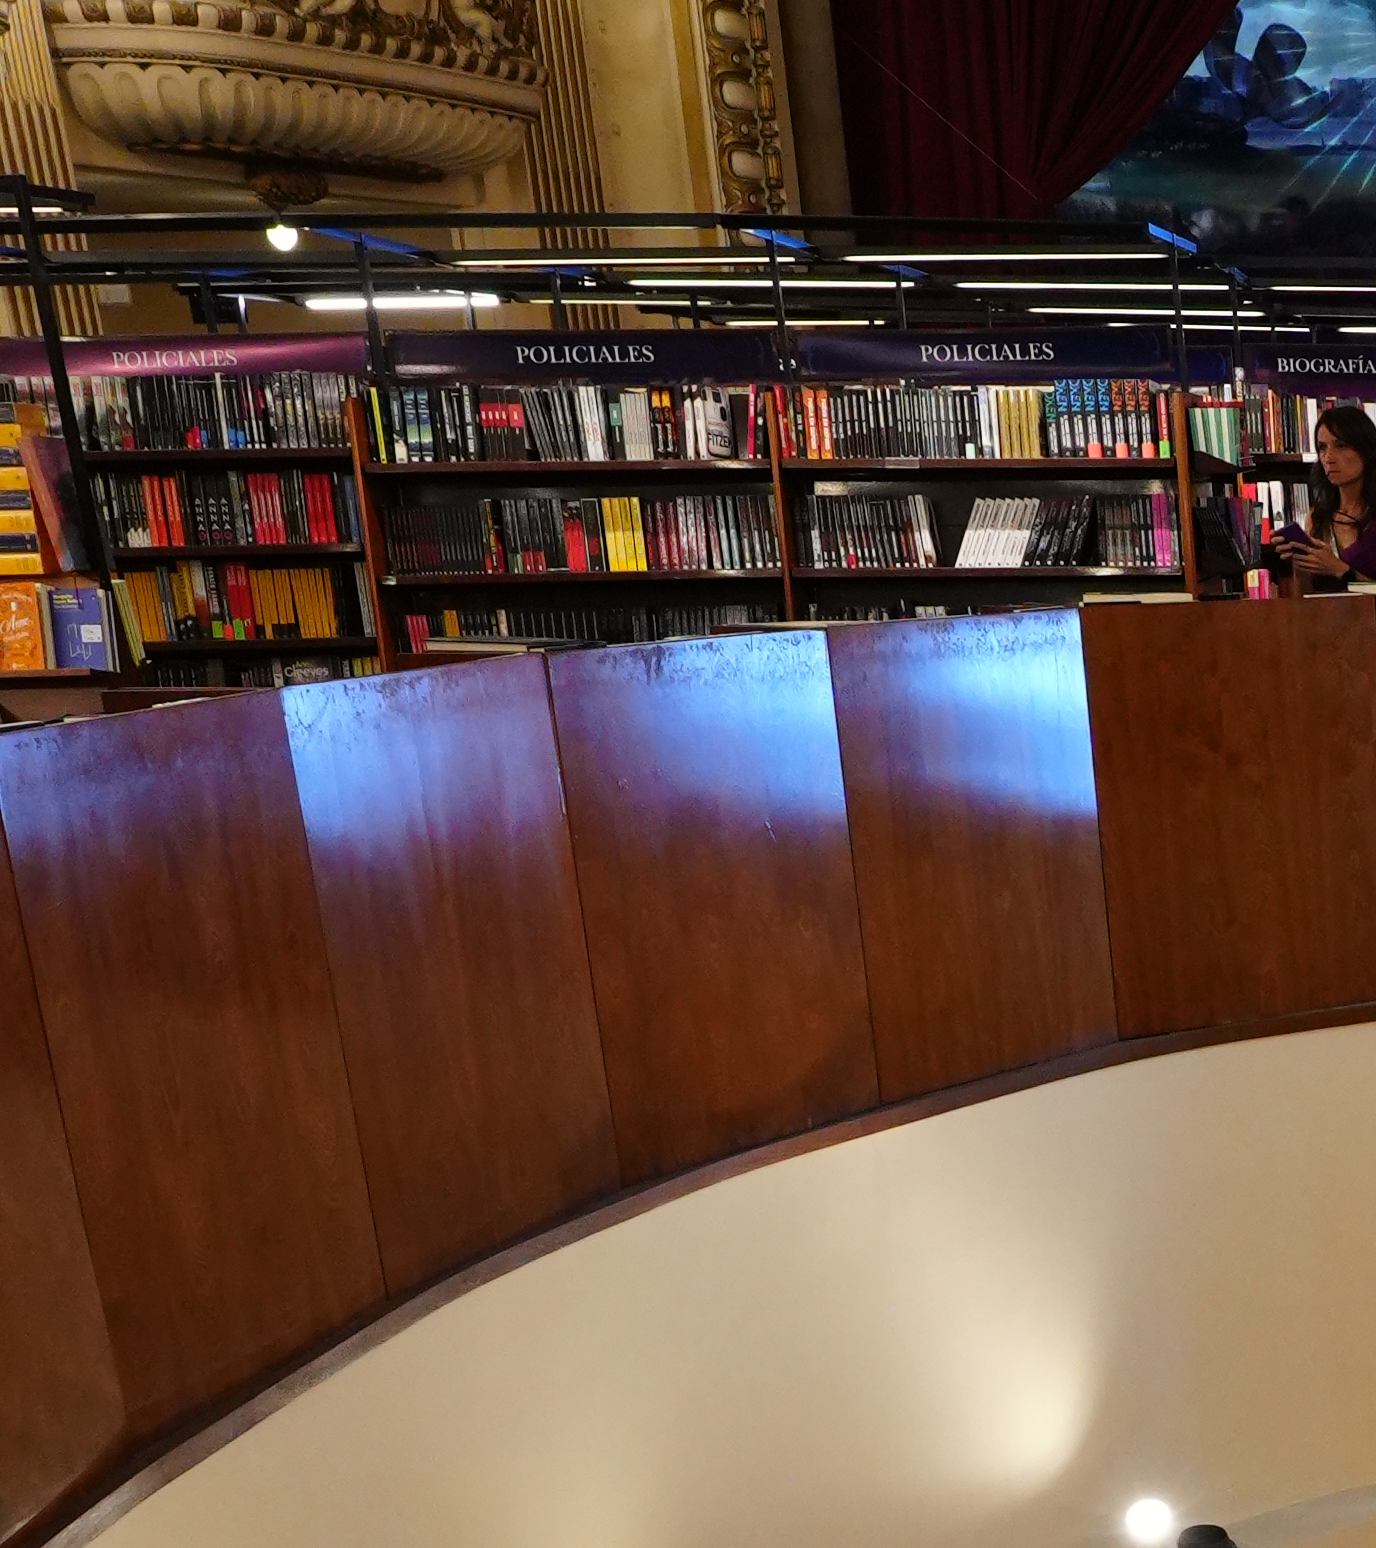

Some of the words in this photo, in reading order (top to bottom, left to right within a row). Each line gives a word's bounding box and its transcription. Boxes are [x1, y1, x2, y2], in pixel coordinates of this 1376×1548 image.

[111, 348, 238, 369] POLICIALES
[515, 344, 656, 365] POLICIALES
[919, 342, 1055, 363] POLICIALES
[1277, 354, 1376, 375] BIOGRAFÍA
